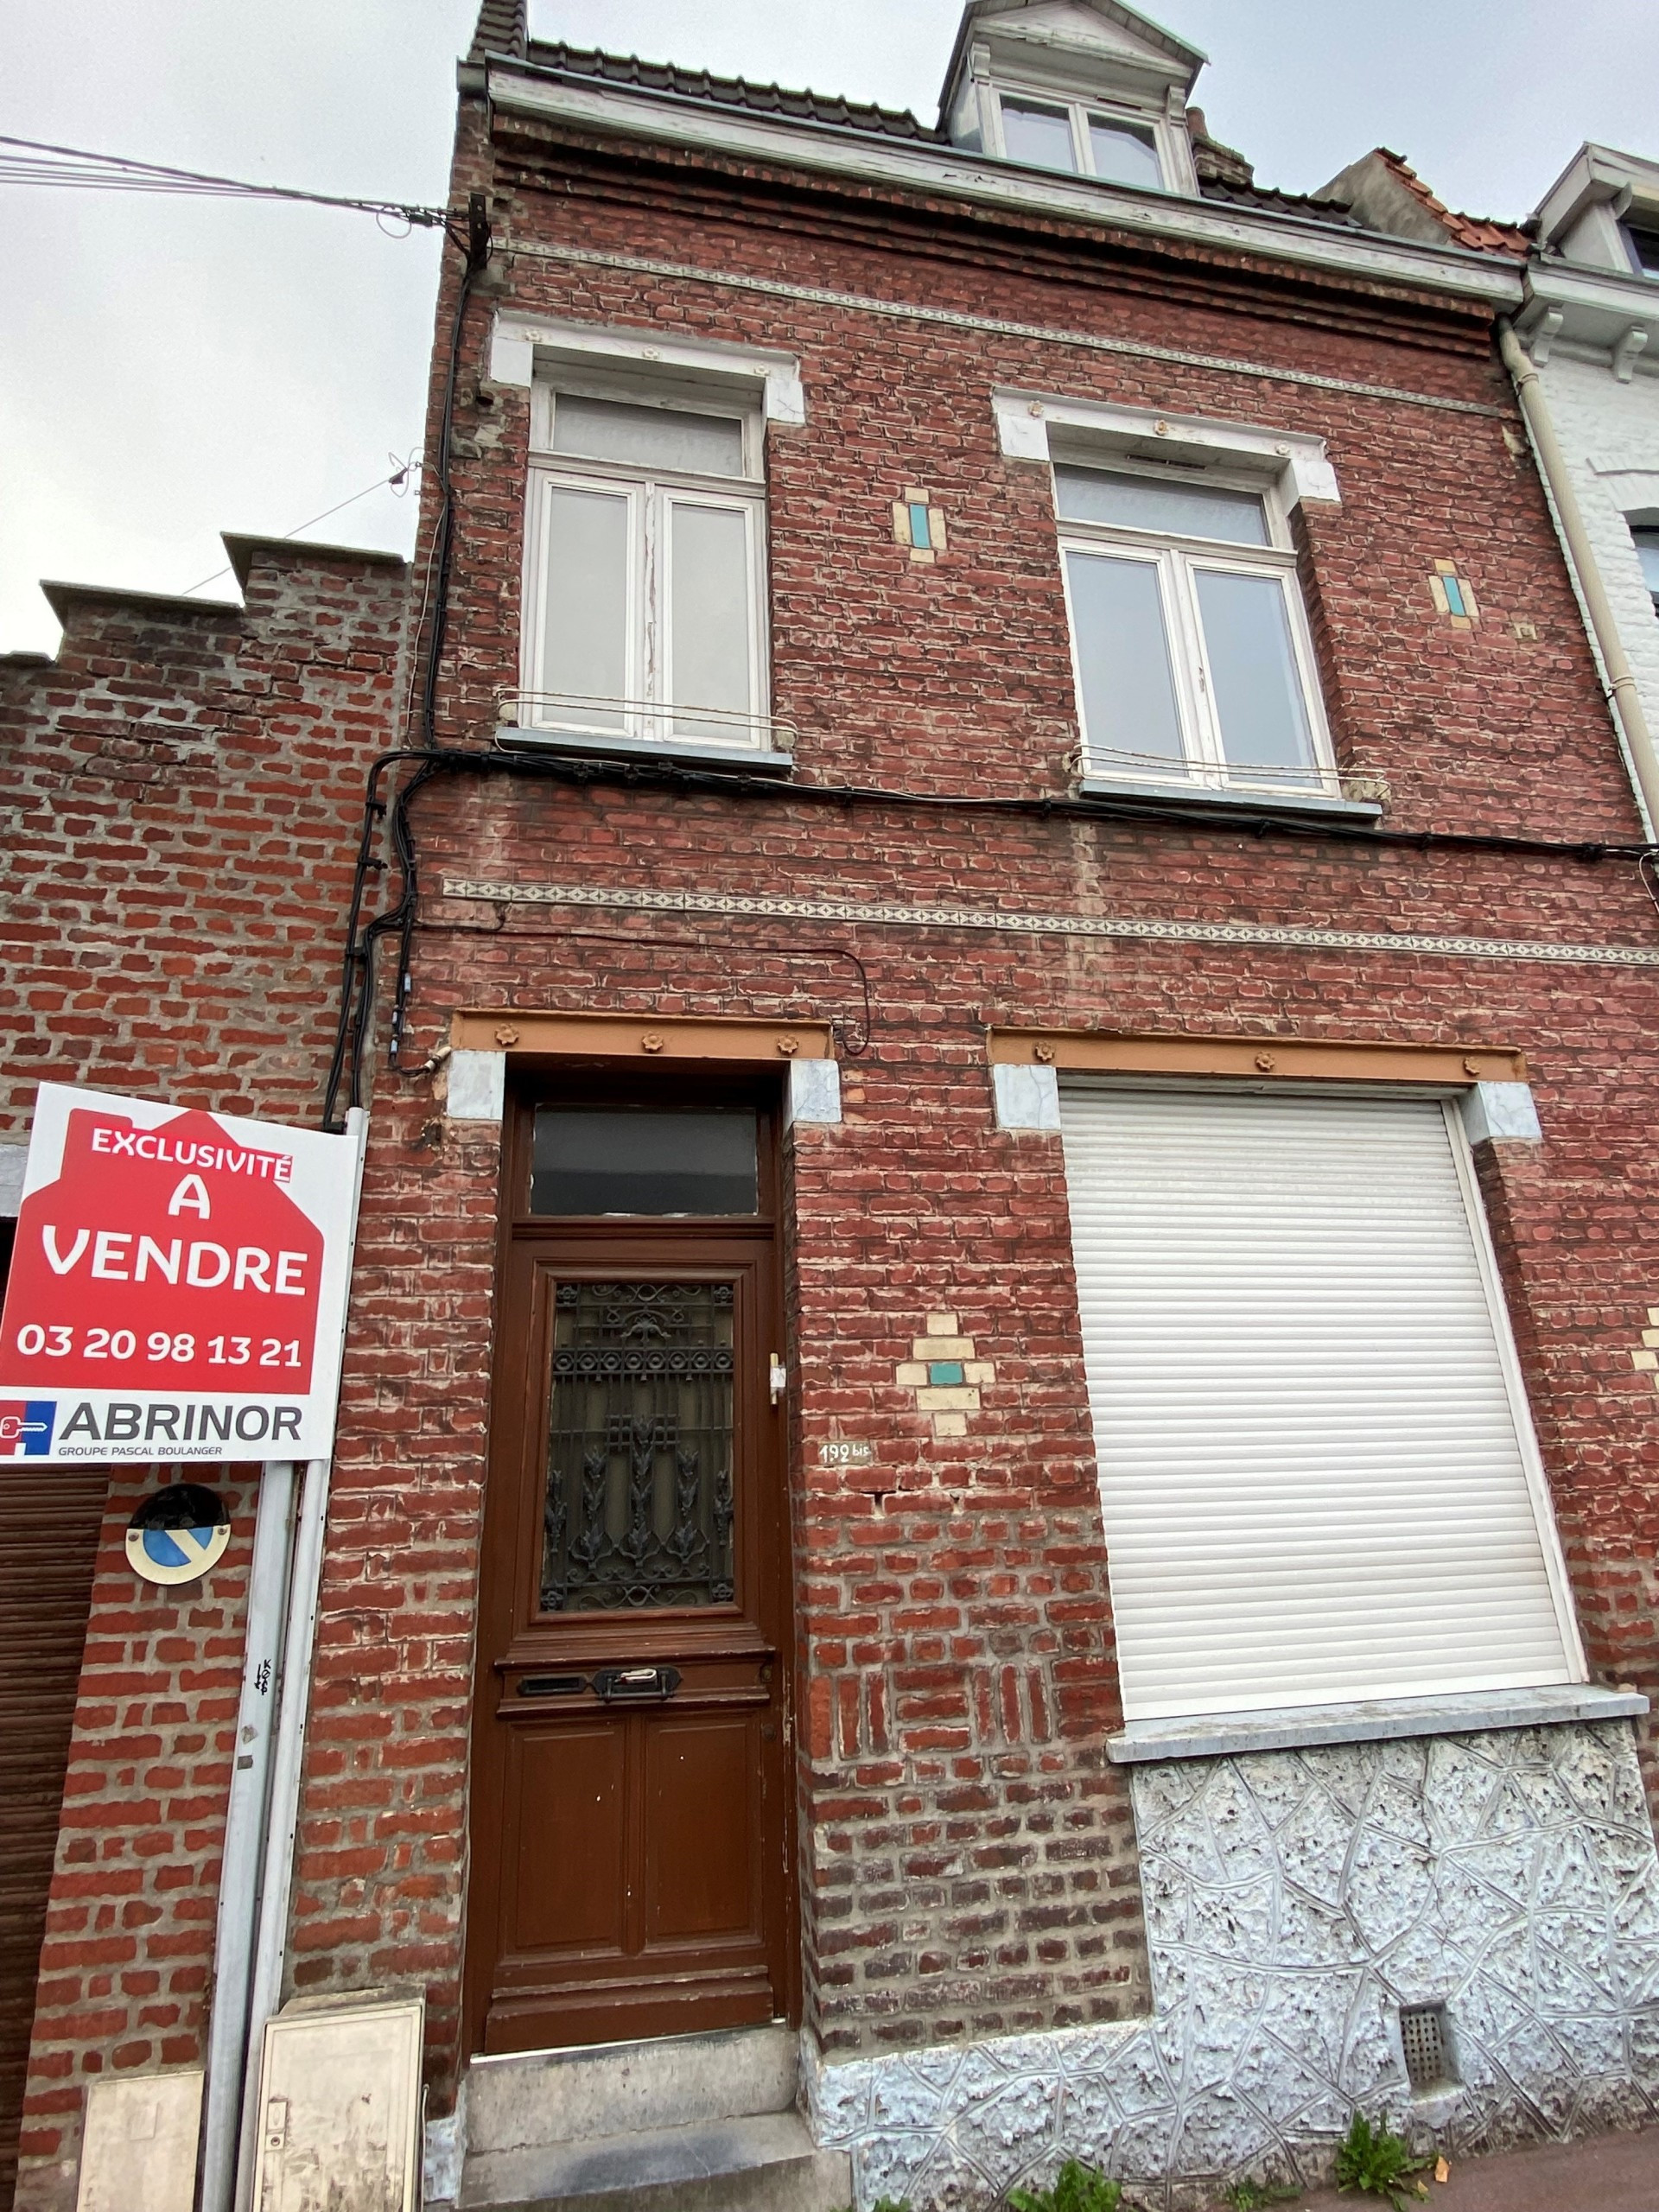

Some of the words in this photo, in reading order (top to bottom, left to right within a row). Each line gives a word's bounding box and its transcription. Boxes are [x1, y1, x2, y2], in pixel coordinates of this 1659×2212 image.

[92, 1128, 292, 1182] EXCLUSIVITÉ
[168, 1173, 211, 1219] A
[42, 1224, 308, 1296] VENDRE
[16, 1324, 74, 1357] 03
[83, 1328, 137, 1360] 20
[147, 1332, 195, 1363] 98
[207, 1335, 251, 1365] 13
[259, 1338, 302, 1367] 21
[58, 1402, 302, 1441] ABRINOR
[59, 1446, 108, 1456] GROUPE
[111, 1446, 155, 1456] PASCAL
[157, 1446, 223, 1456] BOULANGER
[852, 1444, 871, 1457] bis
